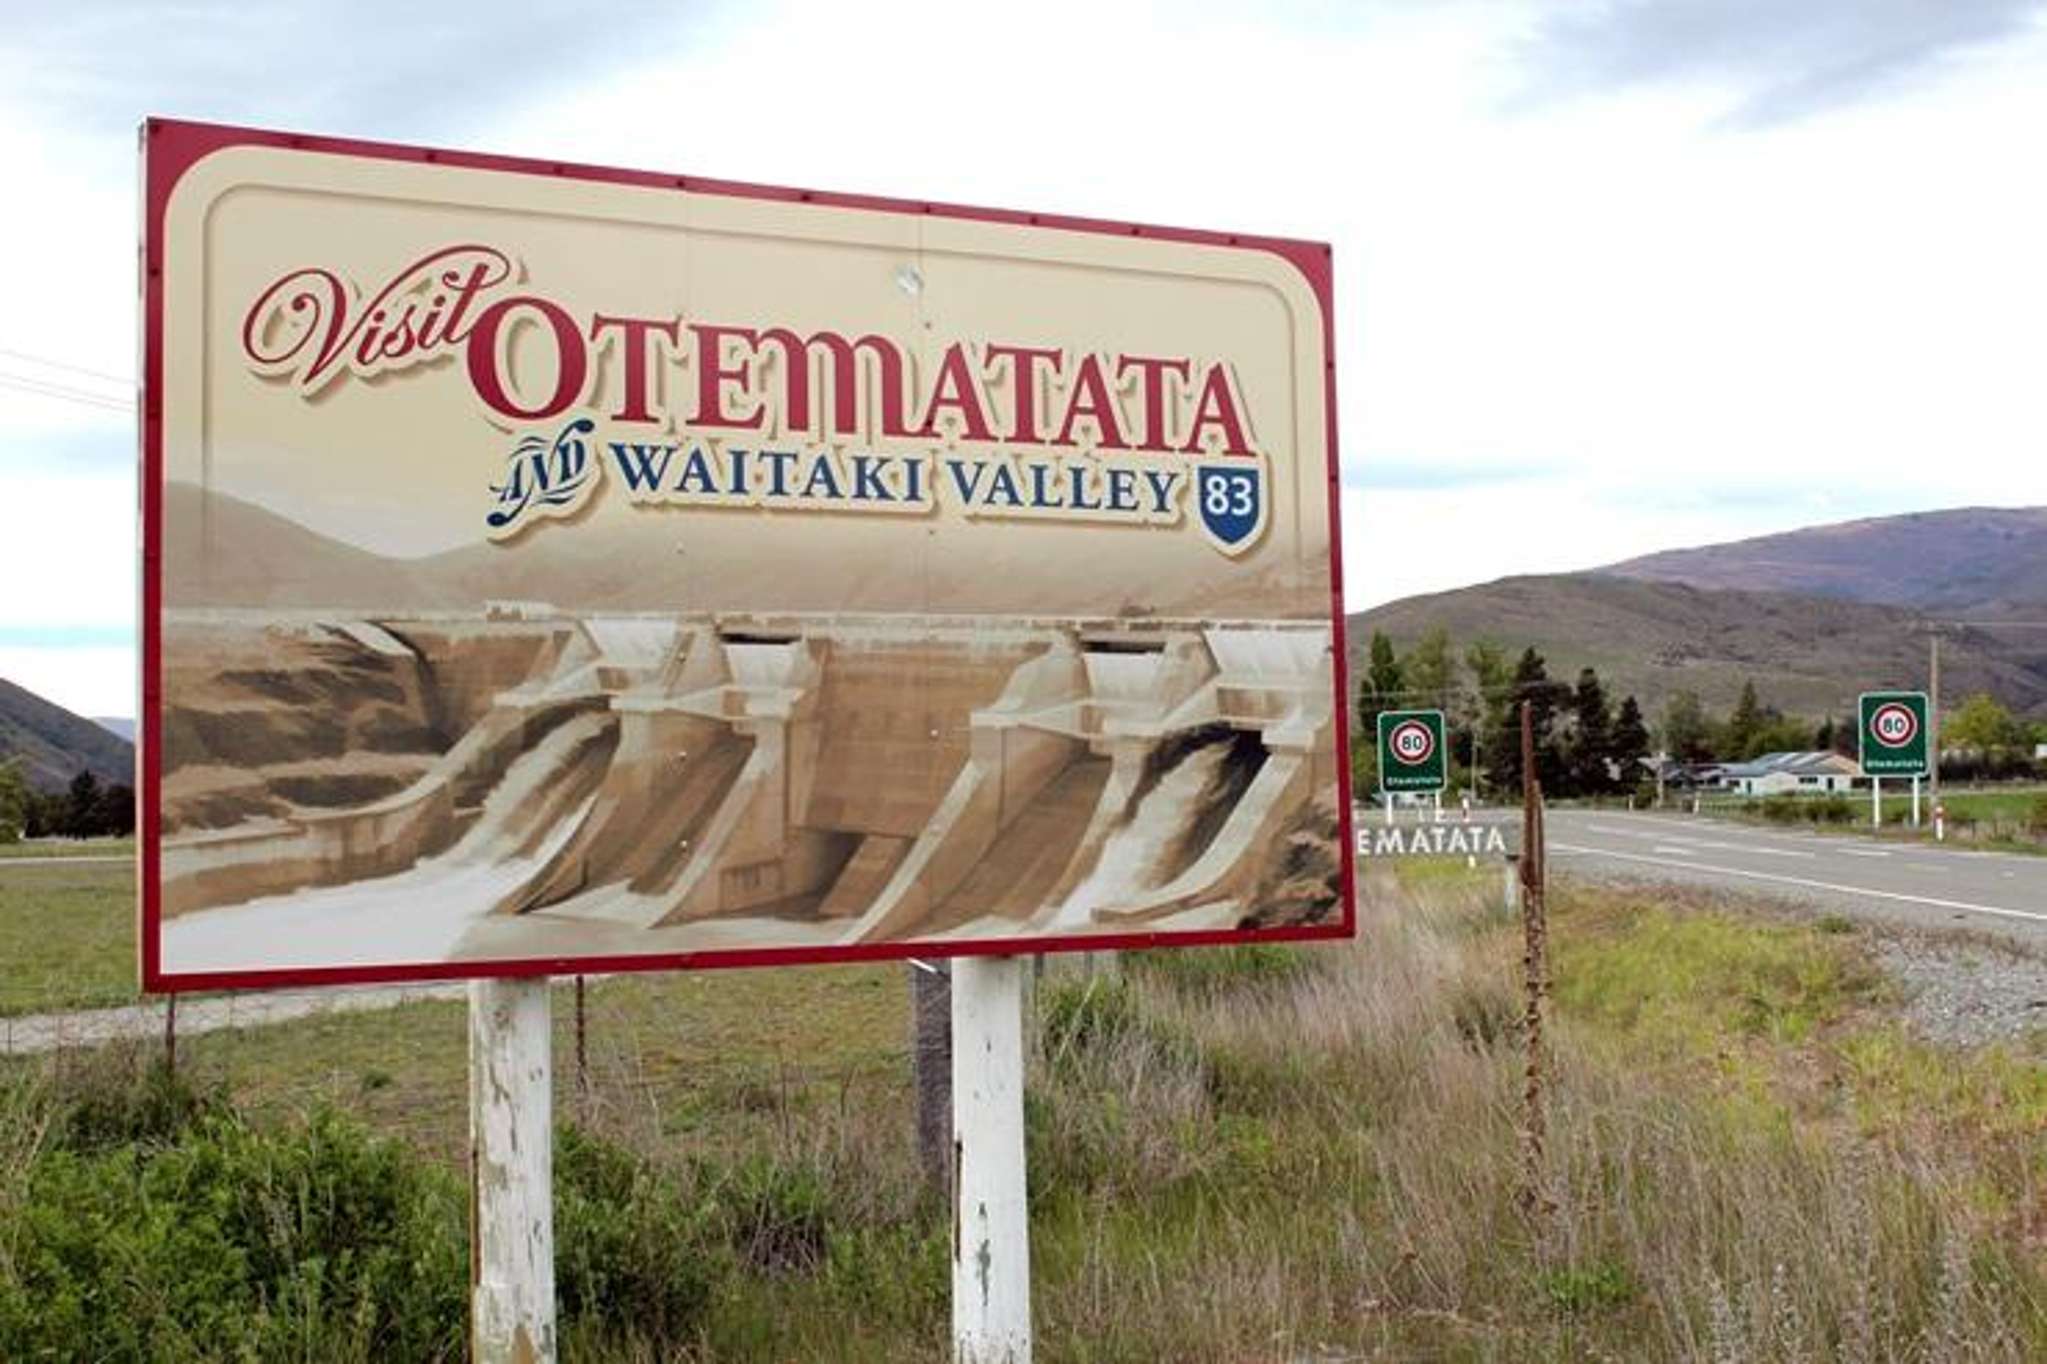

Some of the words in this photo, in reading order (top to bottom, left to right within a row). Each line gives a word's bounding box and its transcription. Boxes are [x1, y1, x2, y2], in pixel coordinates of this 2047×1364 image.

[242, 244, 511, 384] Visit
[466, 294, 1257, 457] OTEMATATA
[487, 419, 596, 526] AND
[609, 441, 924, 502] WAITAKI
[945, 459, 1180, 513] VALLEY
[1204, 474, 1254, 517] 83
[1402, 736, 1423, 750] 80
[1883, 718, 1905, 733] 80
